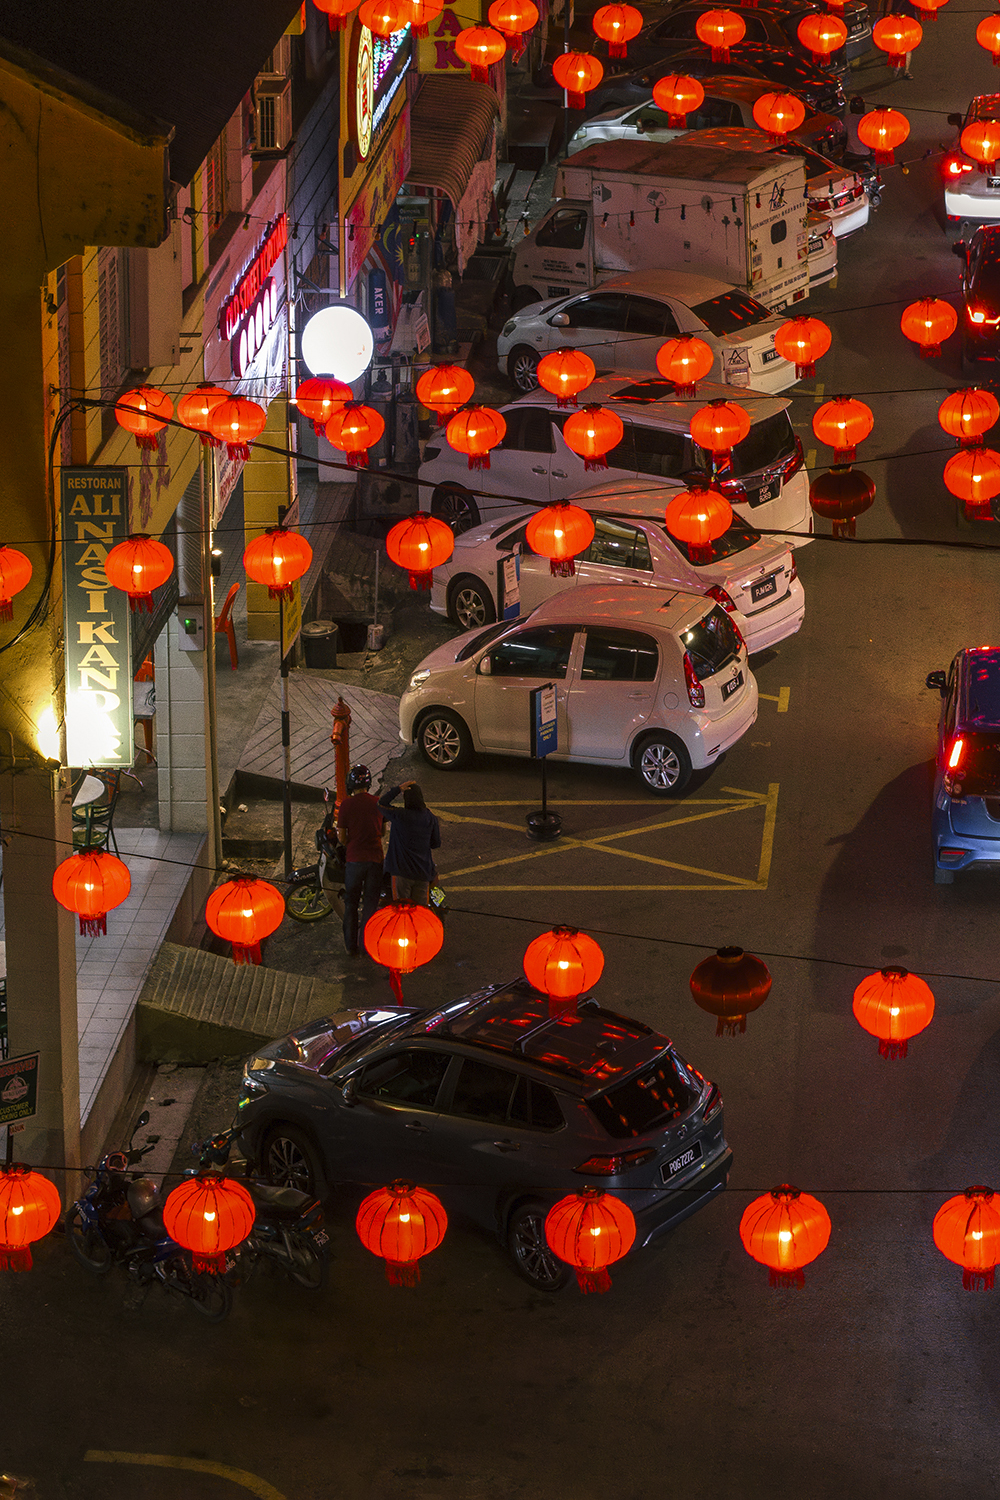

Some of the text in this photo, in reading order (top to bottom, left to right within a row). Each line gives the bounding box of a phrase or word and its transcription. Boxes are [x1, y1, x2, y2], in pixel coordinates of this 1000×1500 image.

[67, 477, 122, 490] RESTORAN
[68, 494, 122, 516] ALI
[75, 521, 118, 613] NASI
[18, 1106, 34, 1117] ONLY
[680, 1149, 695, 1167] 7272
